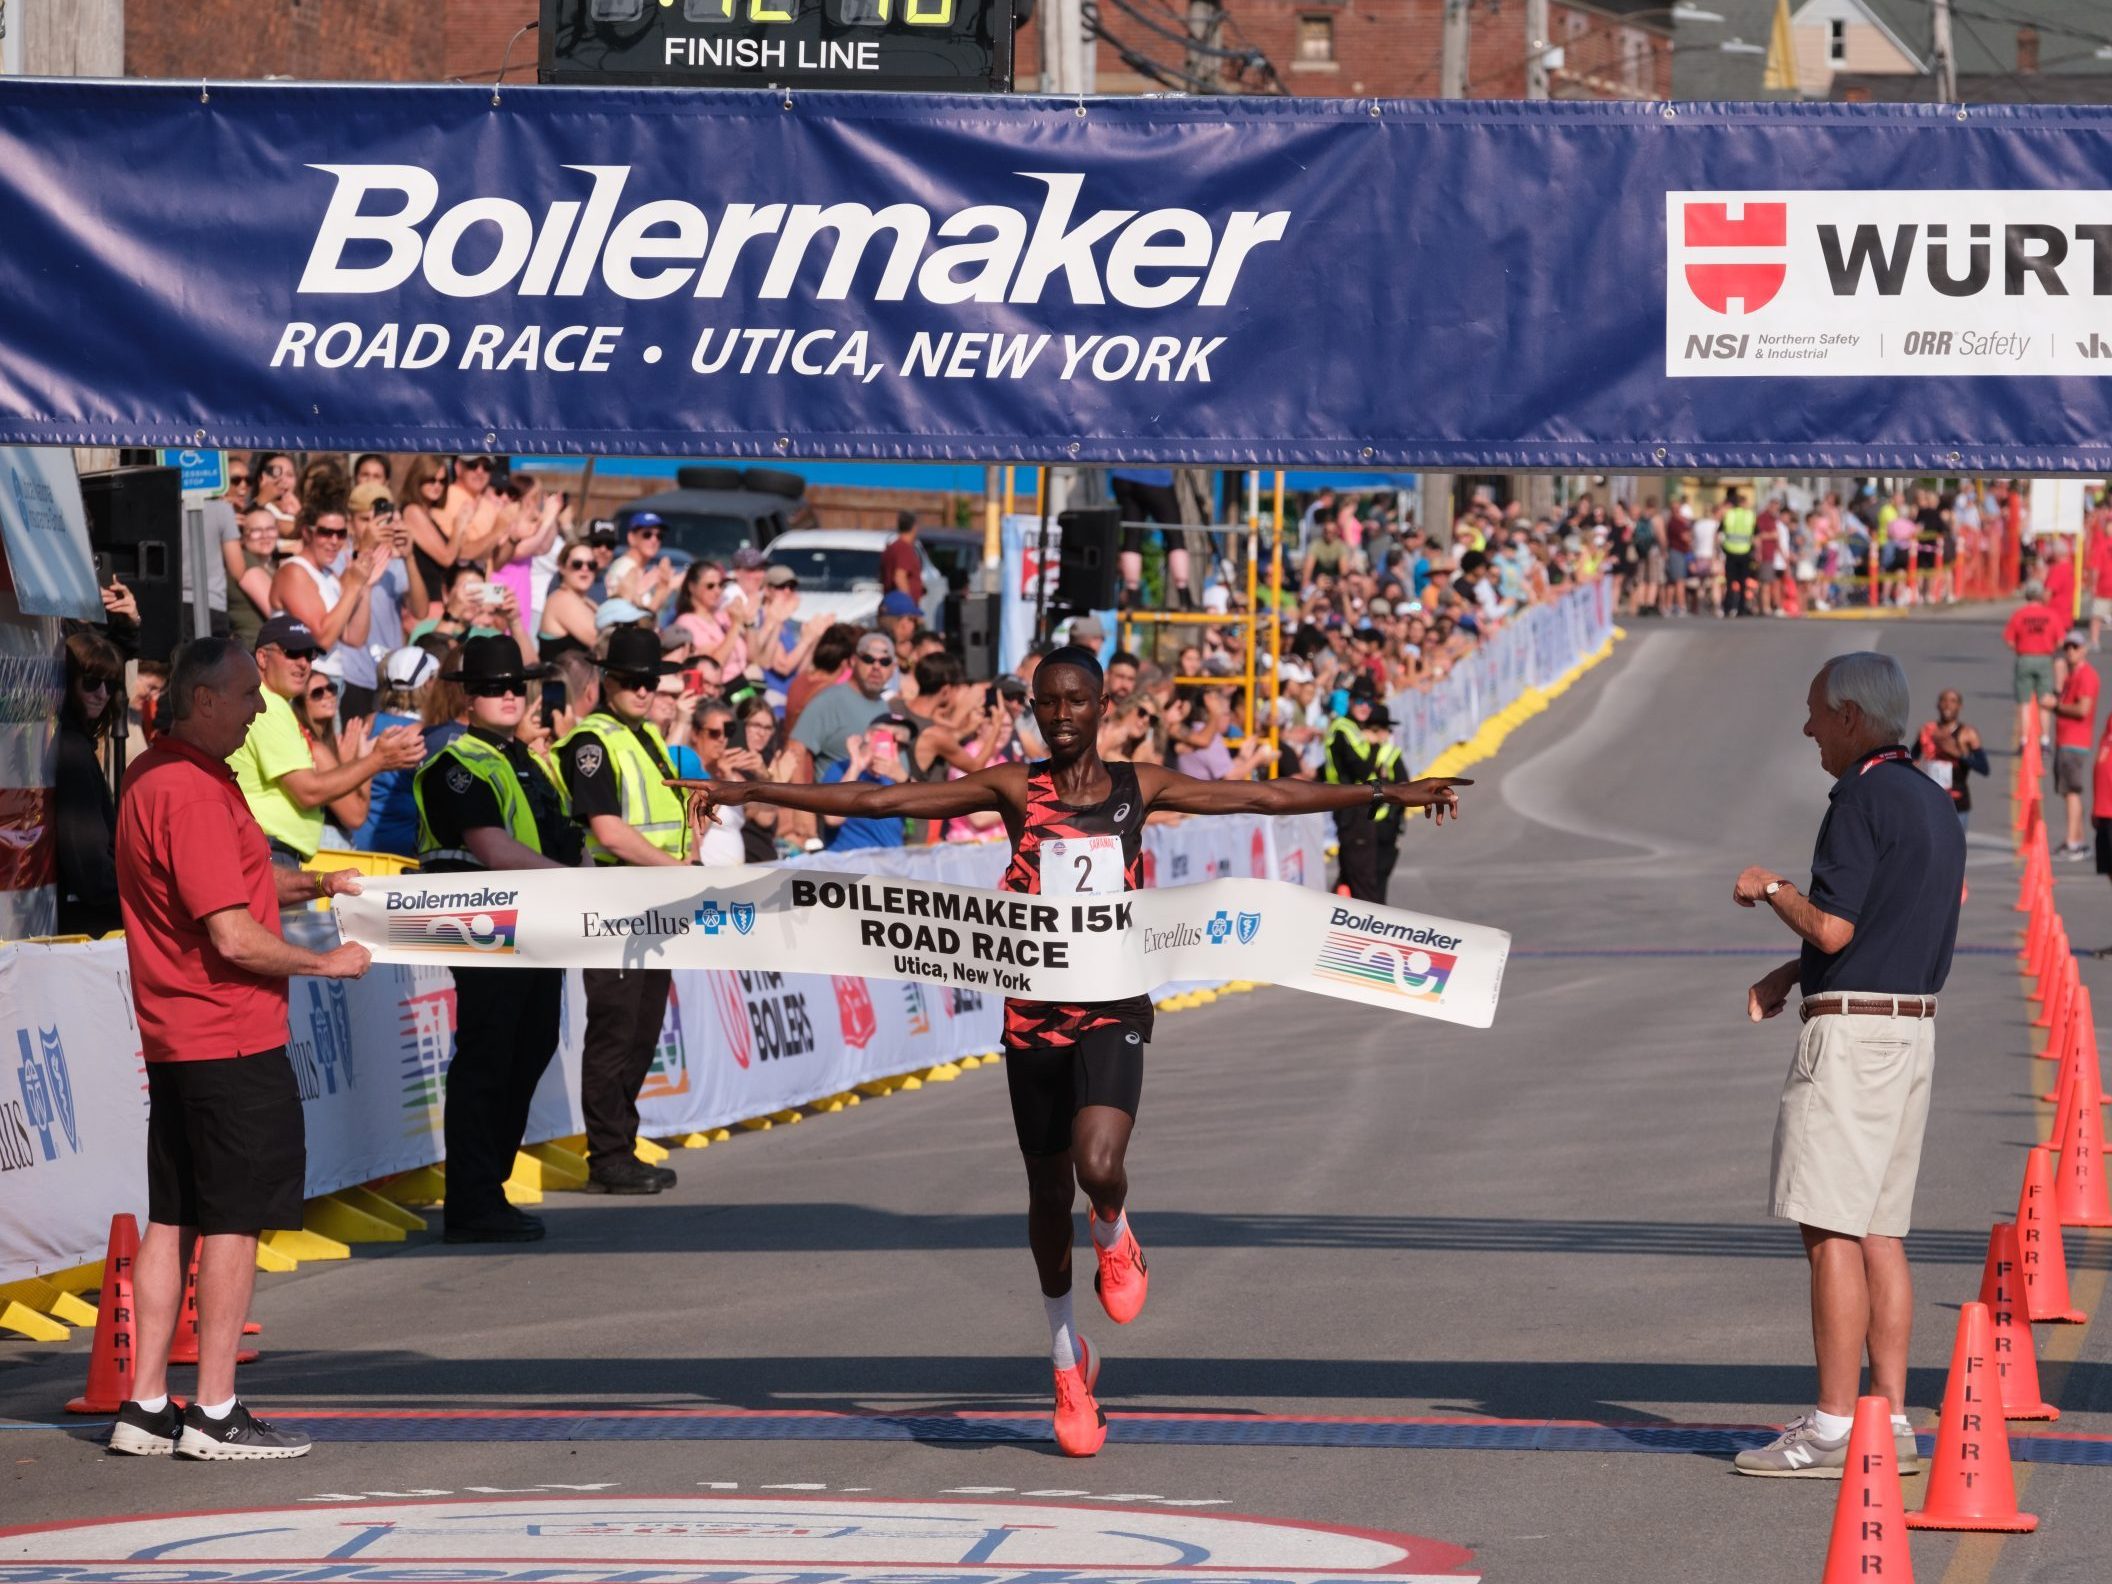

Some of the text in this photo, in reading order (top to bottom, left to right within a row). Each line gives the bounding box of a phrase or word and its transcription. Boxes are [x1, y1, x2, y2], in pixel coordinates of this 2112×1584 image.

[665, 37, 880, 70] FINISH LINE
[297, 163, 1291, 308] Boilermaker
[270, 321, 1228, 383] ROAD RACE UTICA, NEW YORK
[1684, 333, 1750, 359] NSI
[1755, 348, 1828, 360] & Industrial
[1758, 334, 1860, 348] Northern Safety
[1903, 330, 2031, 360] ORR Safety
[1073, 855, 1094, 893] 2
[386, 888, 519, 910] Boilermaker
[792, 879, 1059, 933] BOILERMAKER
[581, 910, 690, 938] Excellus
[1144, 922, 1202, 954] Excellus
[1330, 906, 1463, 951] Boilermaker
[861, 919, 1069, 969] ROAD RACE
[894, 955, 1032, 992] Utica, New York
[748, 992, 815, 1062] BOILERS
[2024, 1185, 2042, 1286] FLRRT
[113, 1257, 131, 1373] FLRRT
[1995, 1261, 2013, 1377] FLRRT
[1960, 1357, 1984, 1489] FLRRT
[296, 1482, 621, 1501] JULY
[938, 1486, 1234, 1506] 2024
